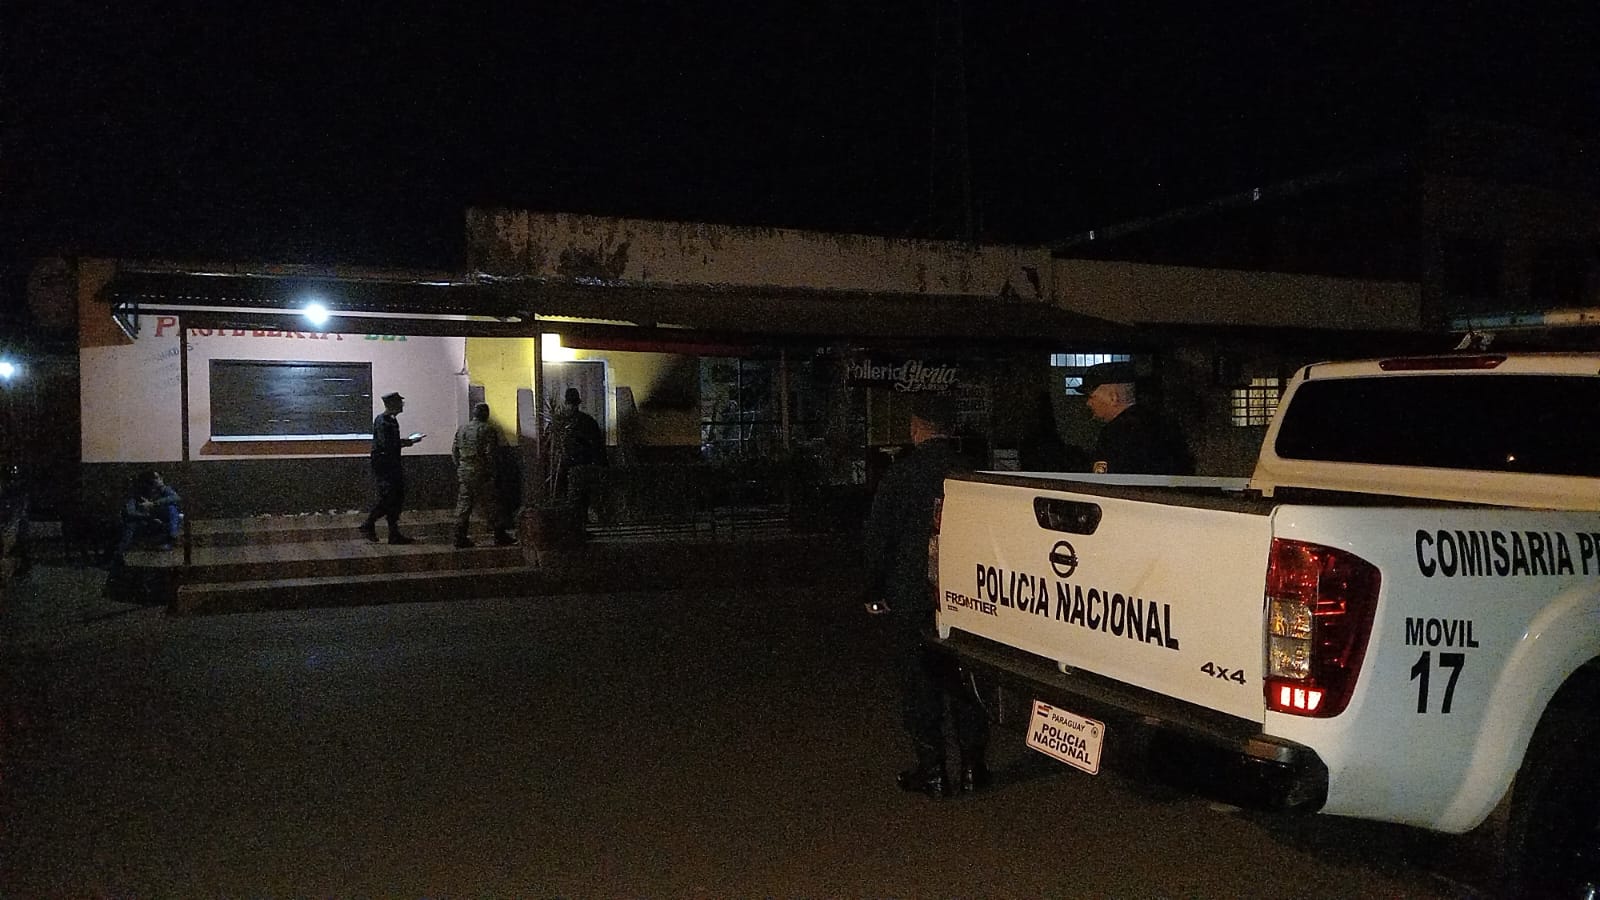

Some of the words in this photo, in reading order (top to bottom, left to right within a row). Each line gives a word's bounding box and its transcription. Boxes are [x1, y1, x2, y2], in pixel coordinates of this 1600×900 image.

[1415, 529, 1575, 577] COMISARIA
[945, 590, 998, 617] FRONTIER
[976, 563, 1049, 617] POLICIA
[1055, 582, 1179, 650] NACIONAL
[1405, 617, 1479, 648] MOVIL
[1200, 662, 1247, 685] 4x4
[1410, 651, 1465, 713] 17
[1041, 723, 1087, 751] POLICIA
[1051, 713, 1086, 732] PARAGUAY
[1033, 731, 1092, 765] NACIONAL
